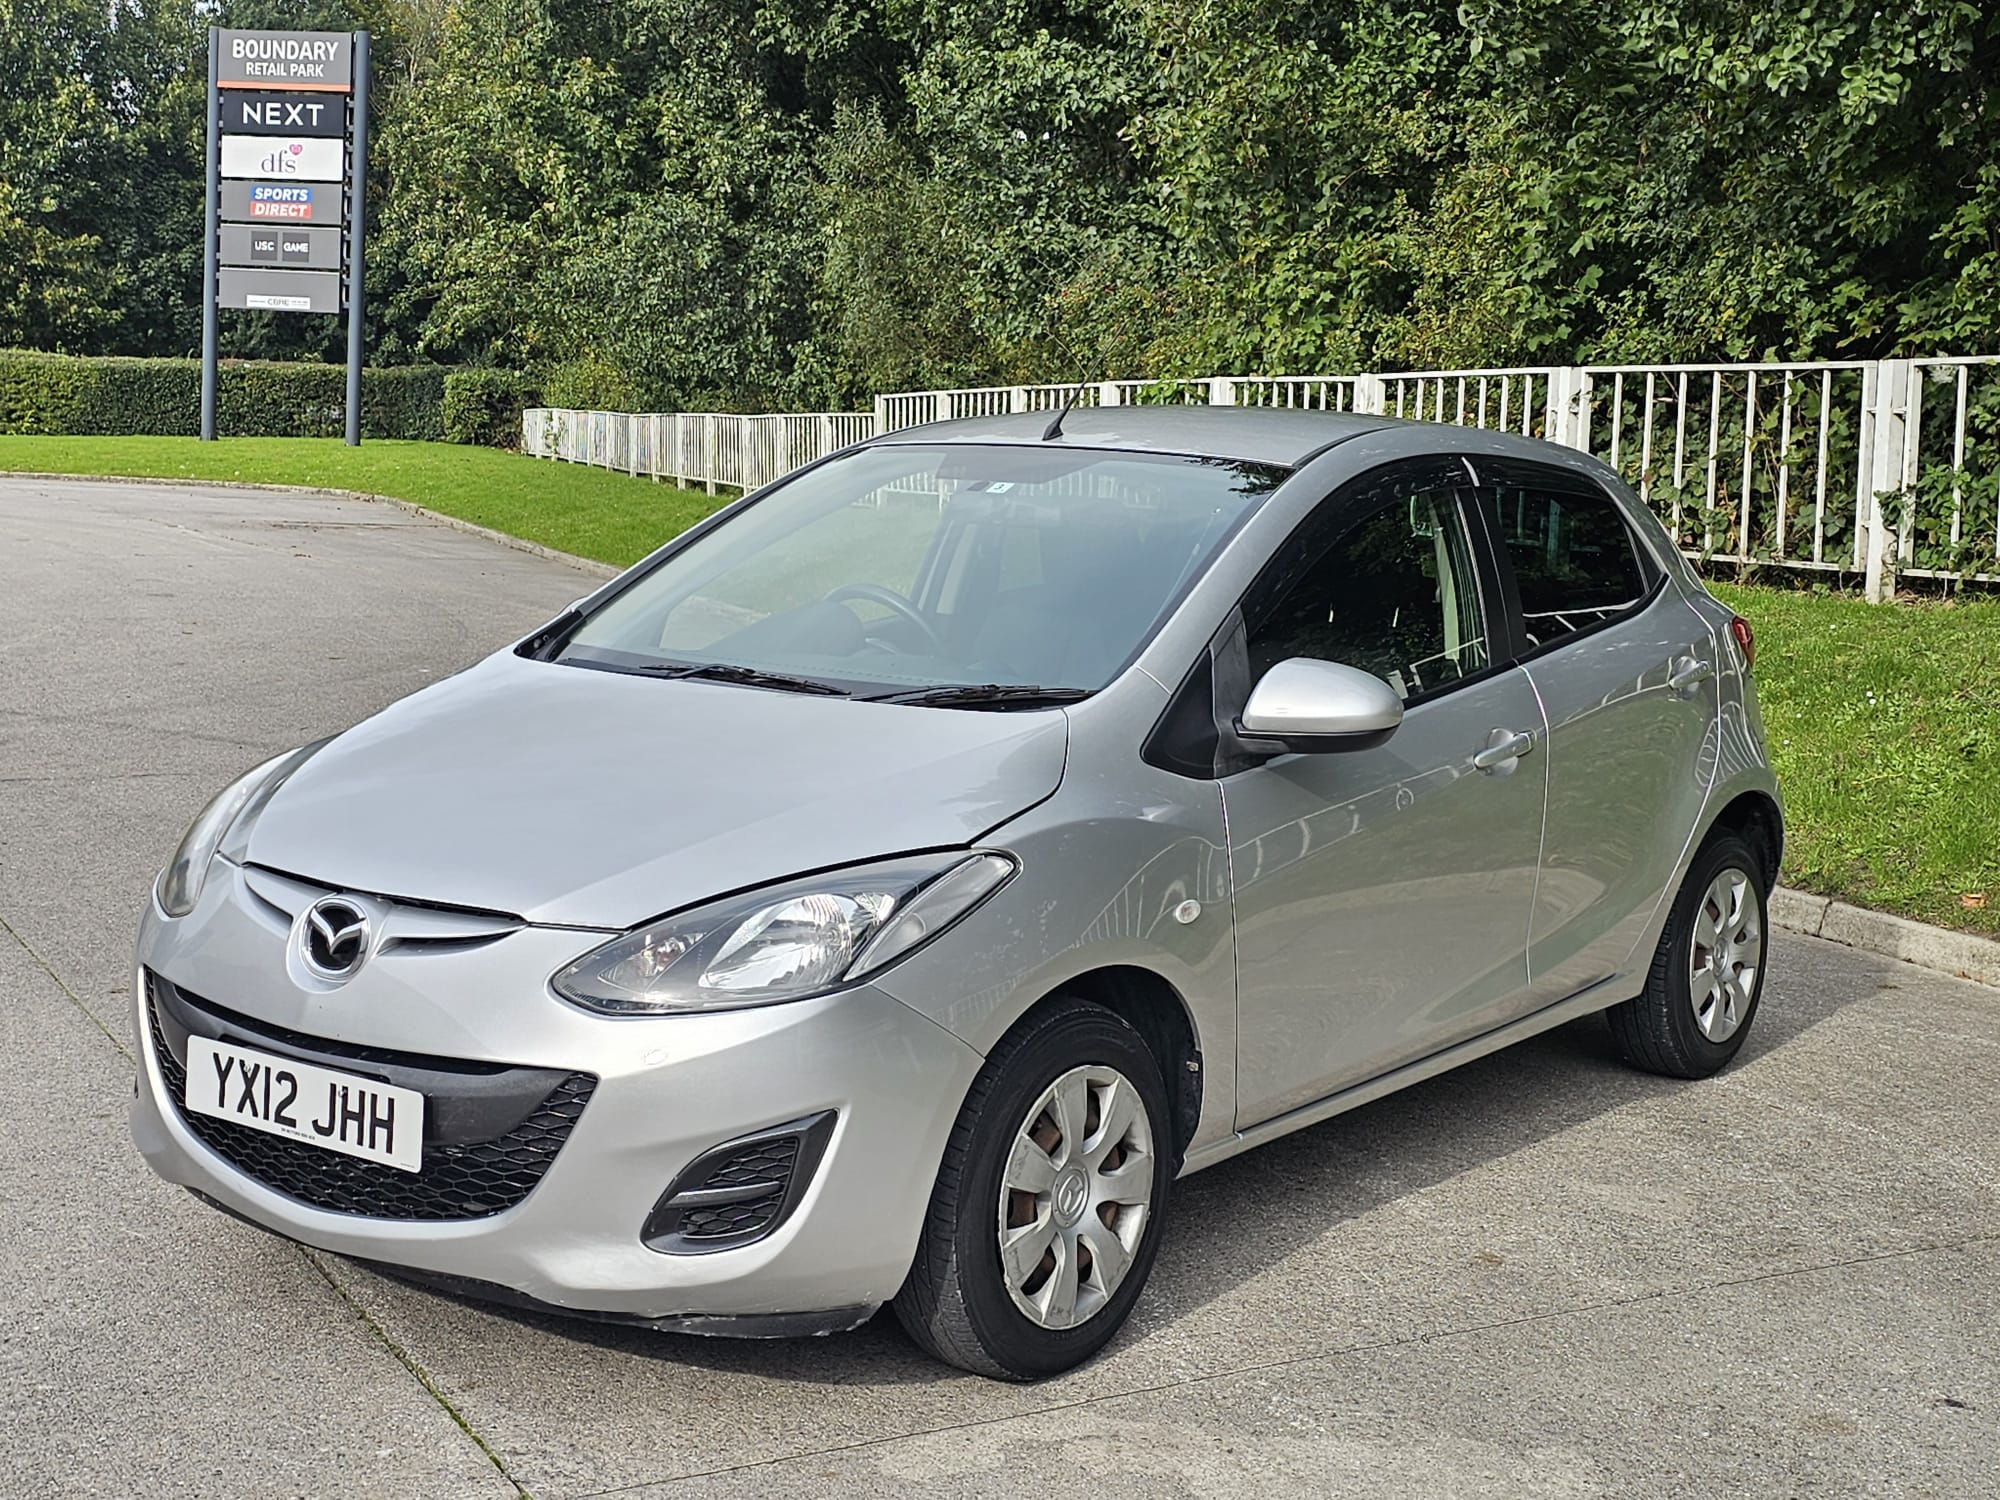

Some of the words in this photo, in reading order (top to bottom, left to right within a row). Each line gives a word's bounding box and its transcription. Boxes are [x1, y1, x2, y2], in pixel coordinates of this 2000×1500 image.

[232, 39, 339, 61] BOUNDARY
[246, 62, 287, 76] RETAIL
[290, 63, 324, 77] PARK
[242, 102, 324, 126] NEXT
[261, 149, 296, 173] dfs
[254, 187, 308, 202] SPORTS
[254, 203, 307, 217] DIRECT
[254, 241, 275, 251] USC
[283, 242, 309, 253] GAME
[212, 1052, 298, 1128] YX12
[311, 1082, 395, 1155] JHH
